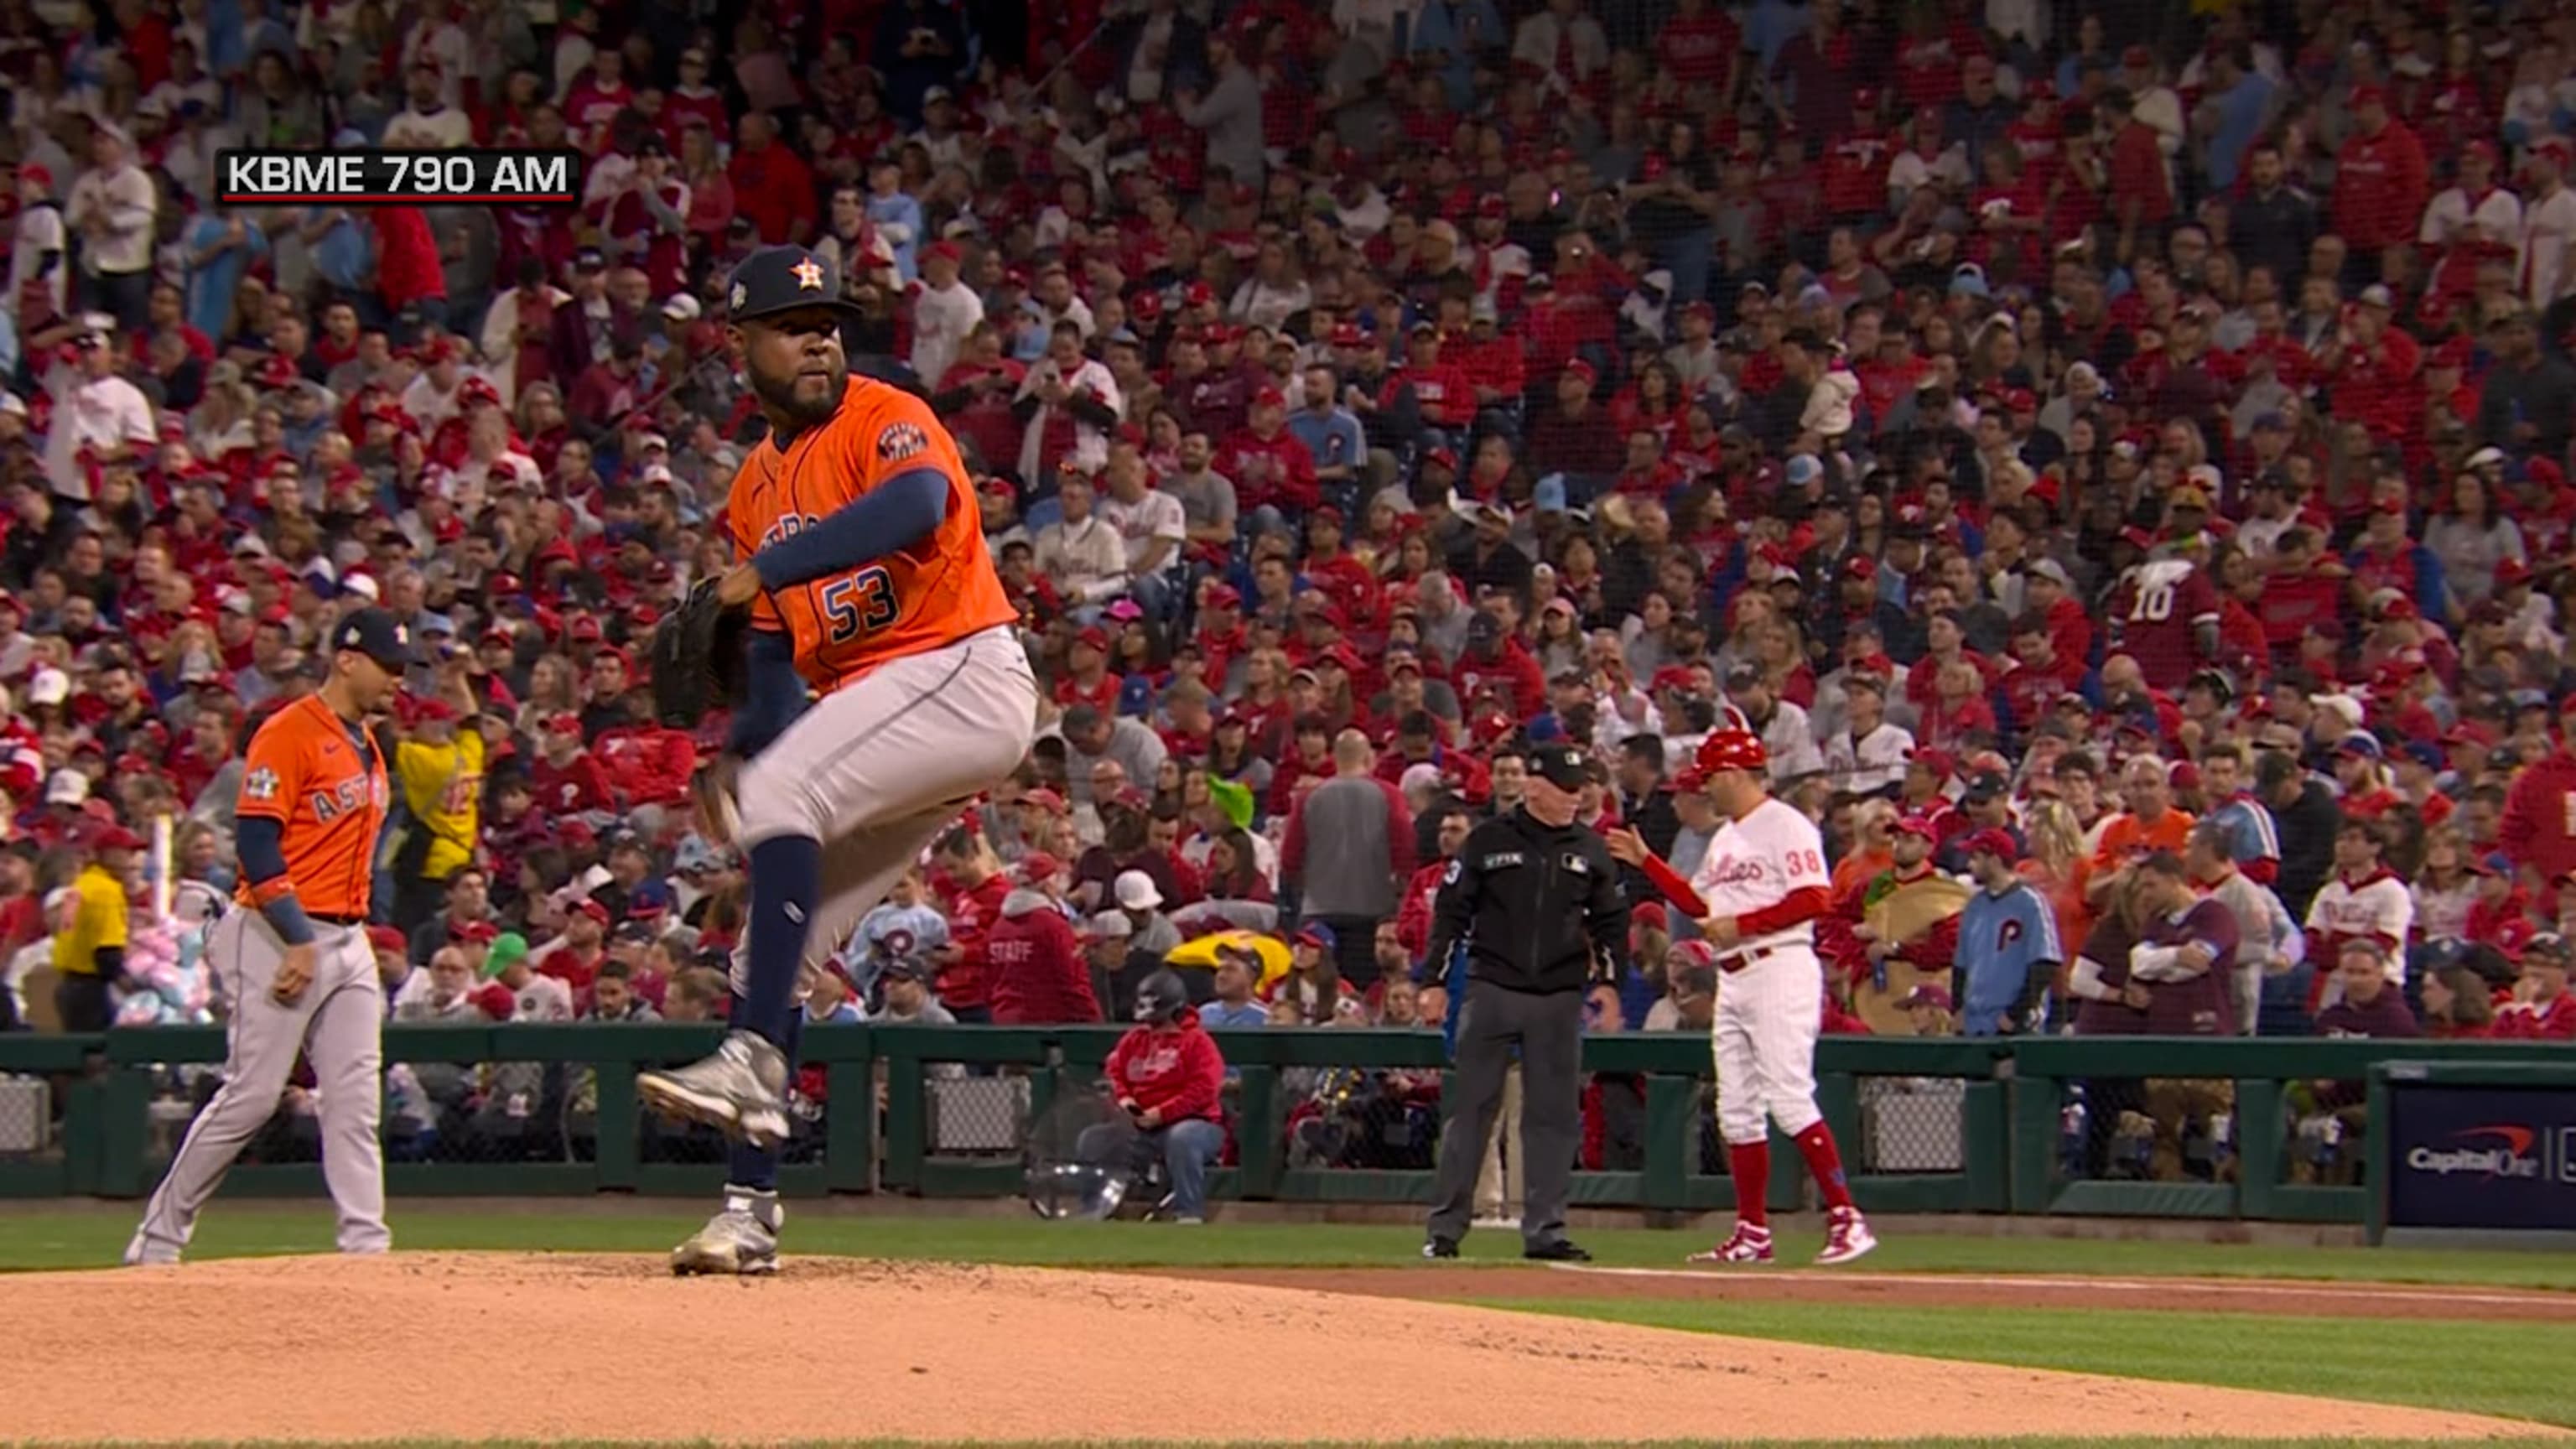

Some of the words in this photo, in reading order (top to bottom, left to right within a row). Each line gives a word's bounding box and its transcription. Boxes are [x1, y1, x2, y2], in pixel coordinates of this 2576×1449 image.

[820, 565, 901, 645] 53
[2130, 584, 2174, 621] 10
[1785, 849, 1820, 876] 38
[989, 940, 1034, 964] STAFF
